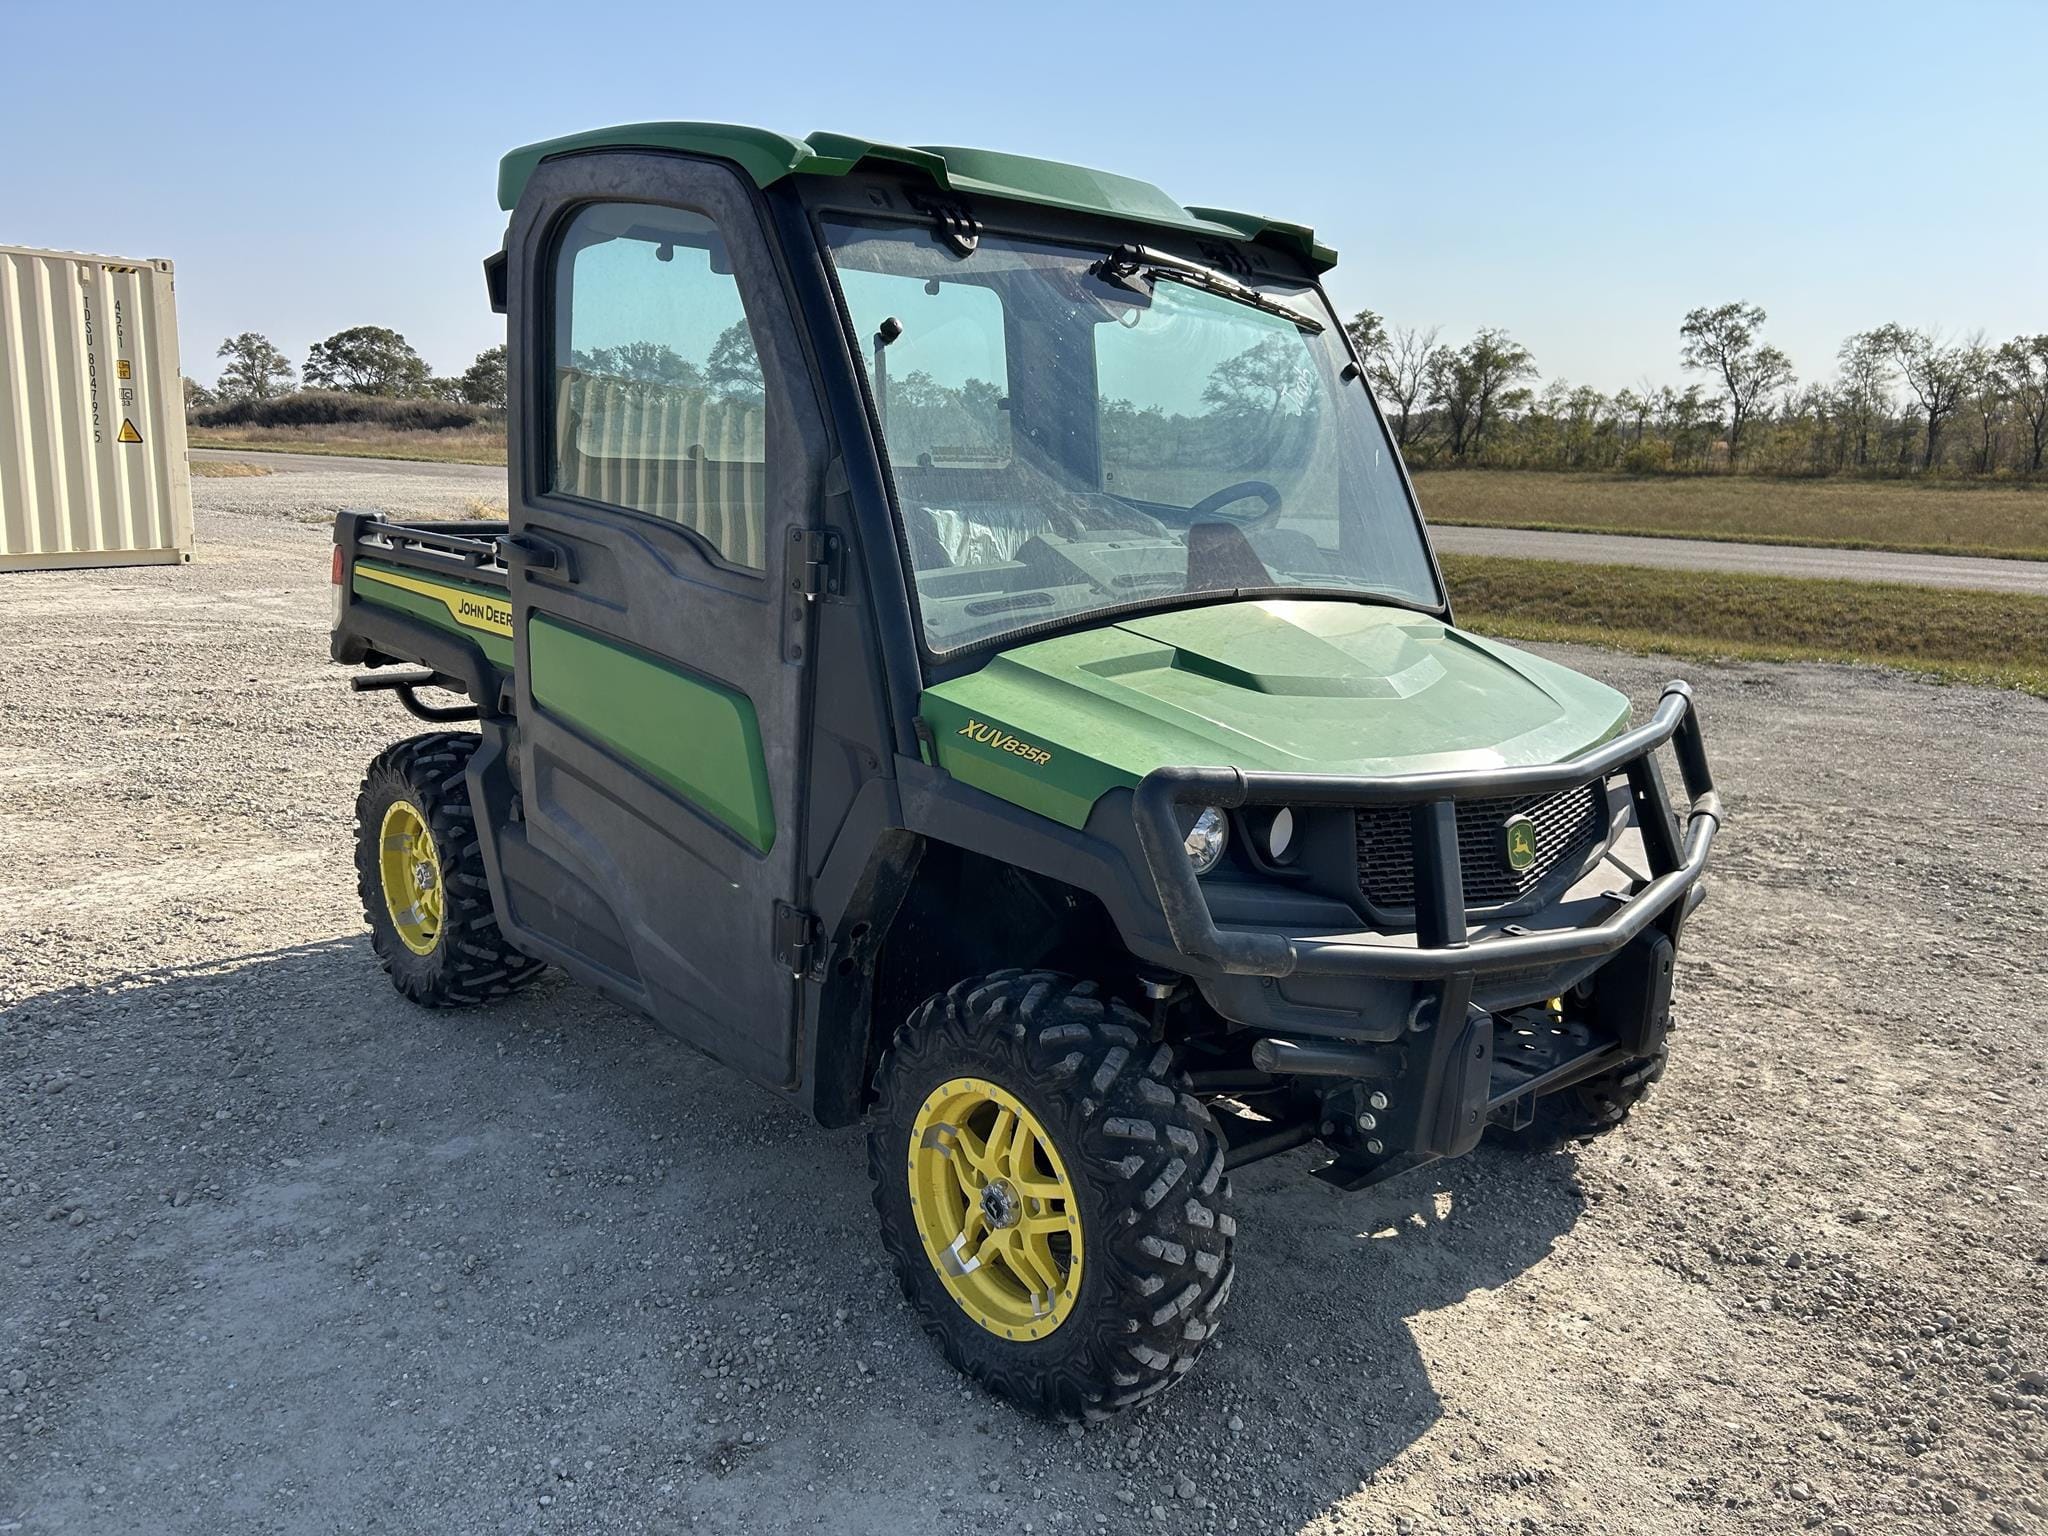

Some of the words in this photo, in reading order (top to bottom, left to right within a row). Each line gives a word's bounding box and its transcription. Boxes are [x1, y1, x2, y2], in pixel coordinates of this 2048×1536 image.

[84, 296, 93, 346] TDSU
[458, 598, 484, 619] JOHN
[486, 605, 513, 627] DEER
[957, 719, 1052, 766] XUV835R
